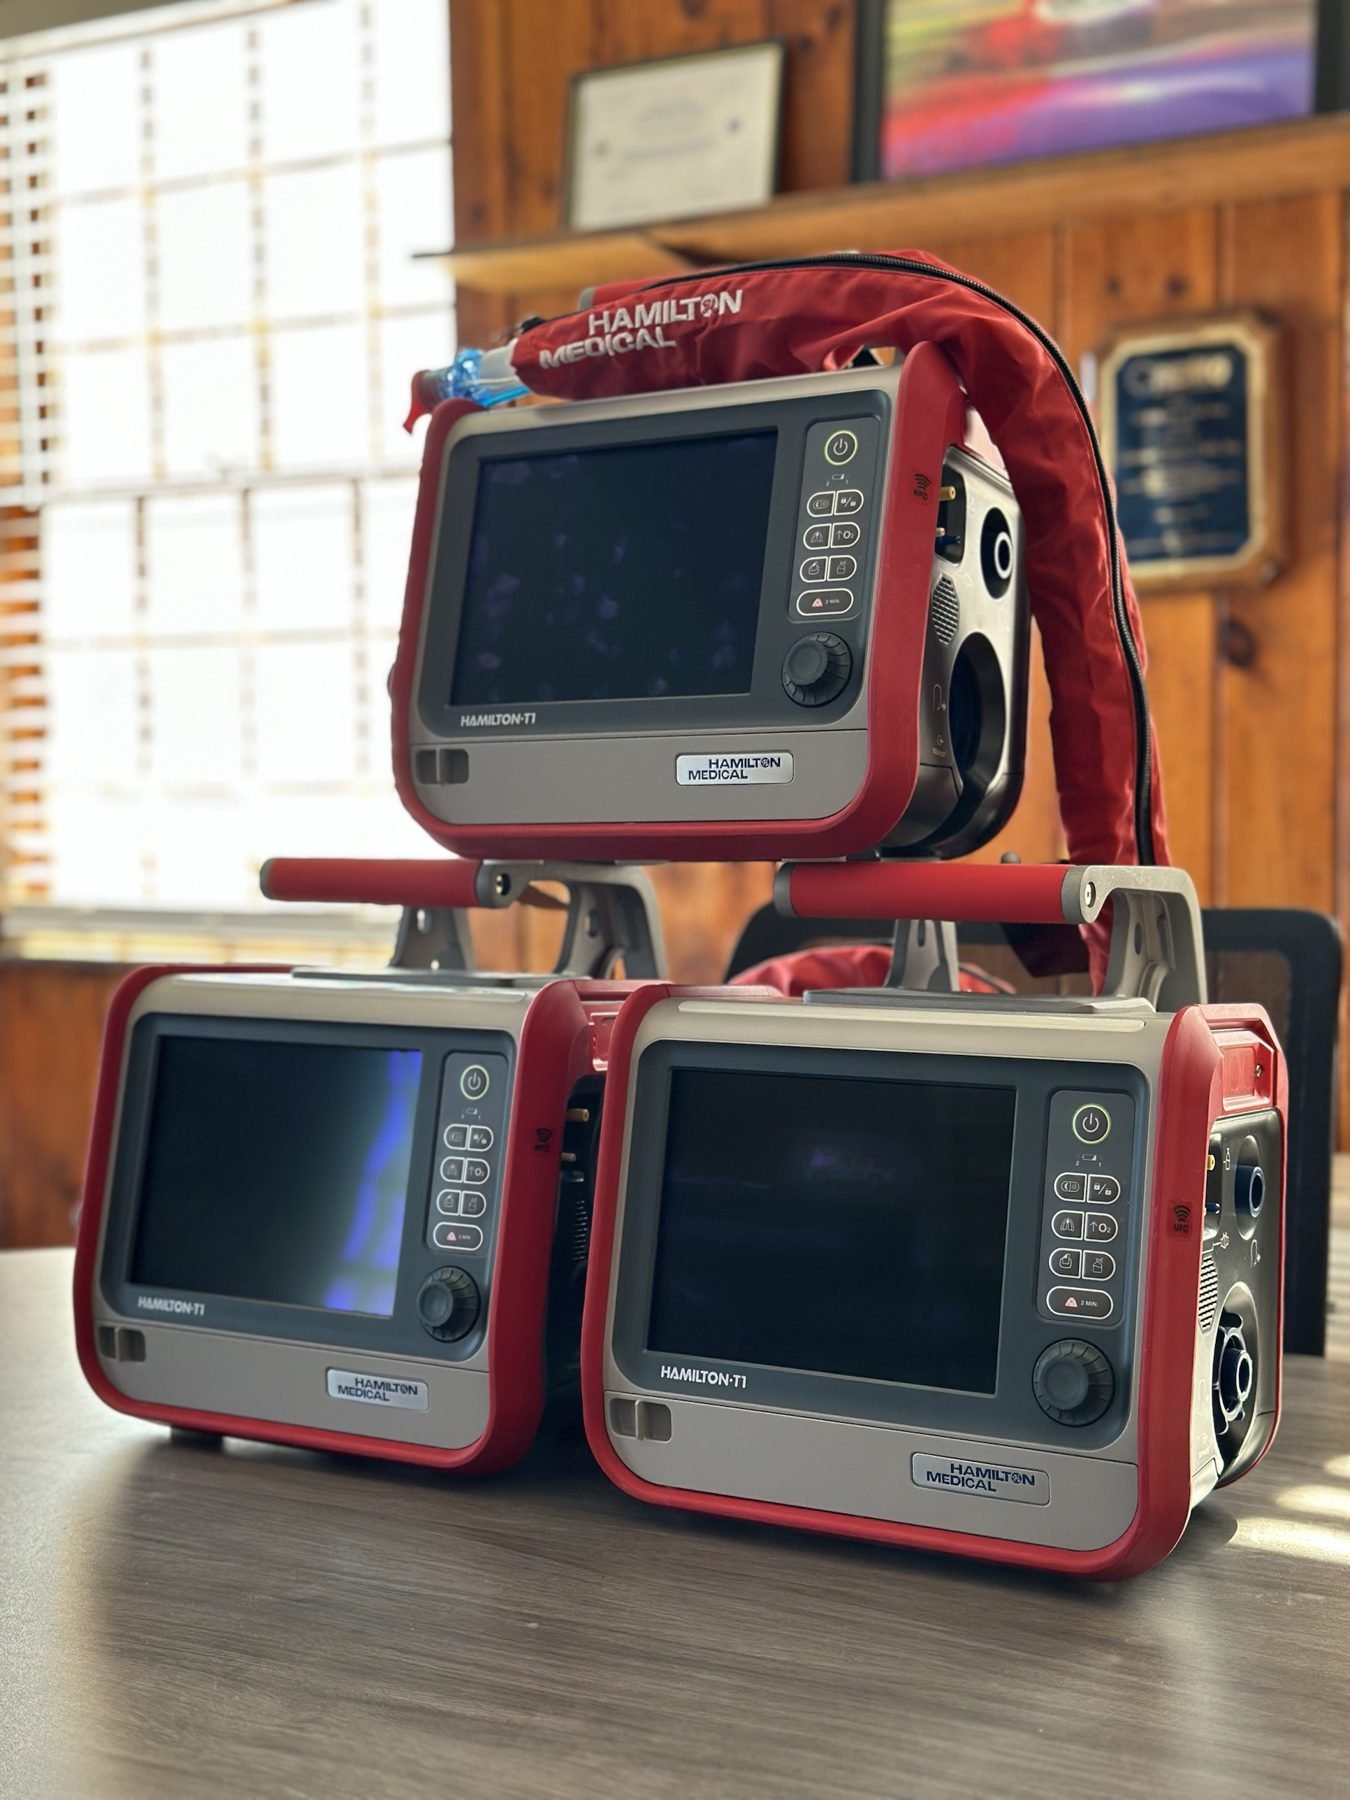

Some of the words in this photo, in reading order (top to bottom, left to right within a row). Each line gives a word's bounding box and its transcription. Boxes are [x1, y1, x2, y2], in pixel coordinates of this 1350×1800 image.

[588, 289, 743, 336] HAMILTON
[539, 326, 676, 369] MEDICAL
[708, 757, 782, 769] HAMILTON
[688, 769, 749, 781] MEDICAL
[337, 1384, 391, 1402] MEDICAL
[354, 1377, 419, 1396] HAMILTON
[926, 1471, 998, 1492] MEDICAL
[949, 1463, 1036, 1487] HAMILTON
